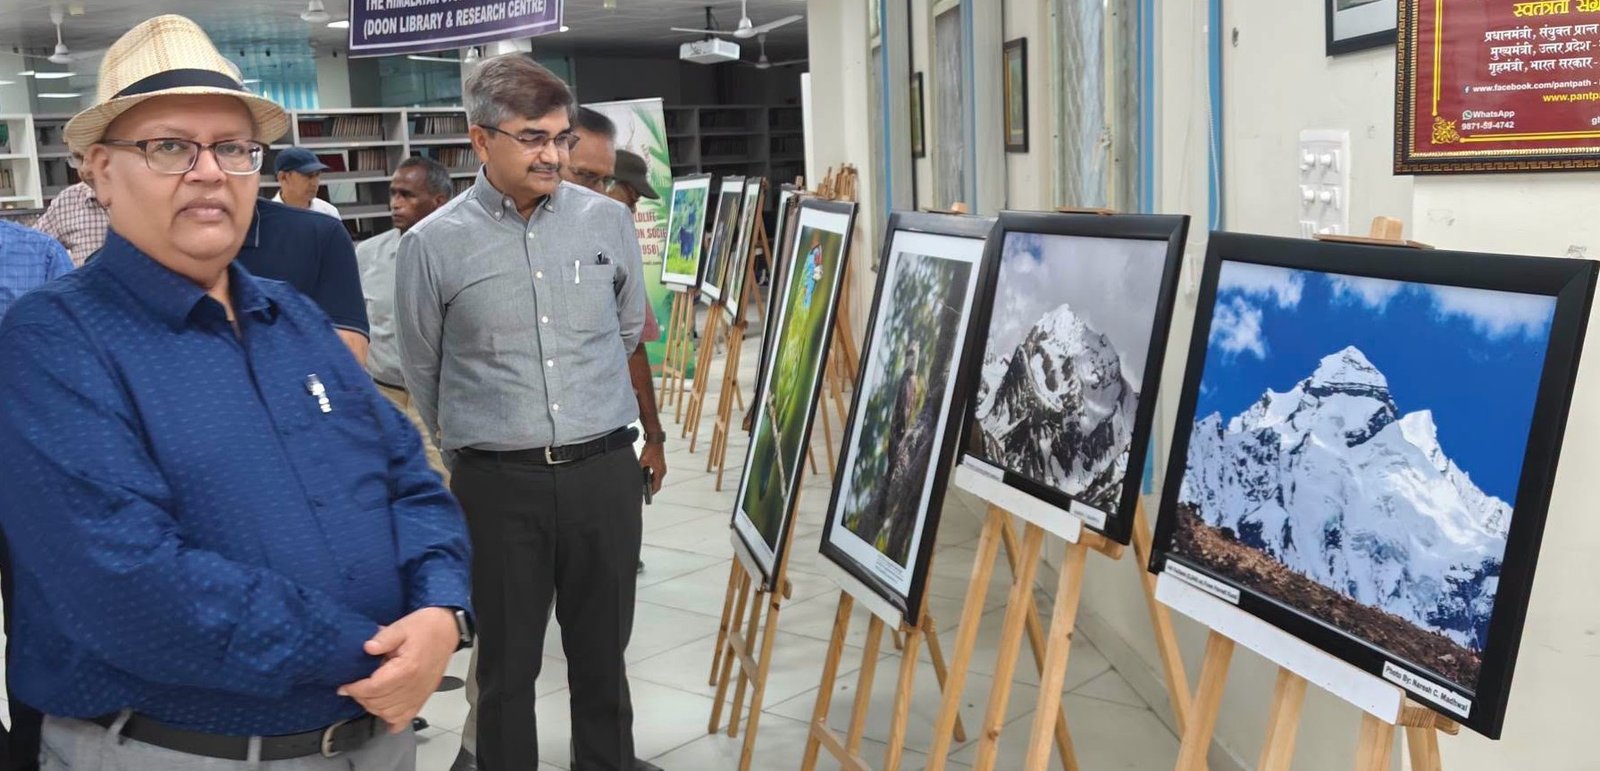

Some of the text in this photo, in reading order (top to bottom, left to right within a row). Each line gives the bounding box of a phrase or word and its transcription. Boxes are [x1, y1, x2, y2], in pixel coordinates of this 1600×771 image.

[363, 0, 547, 40] (DOON LIBRARY & RESEARCH CENTRE)
[1564, 38, 1591, 53] प्रदेश
[1530, 59, 1557, 73] भारत
[1559, 57, 1593, 72] सरकार
[1473, 79, 1591, 92] www.facebook.com/pantpath
[1543, 91, 1600, 103] www.pantp
[1473, 110, 1515, 118] WhatsApp
[1385, 665, 1402, 679] Photo
[1412, 678, 1432, 694] Naresh
